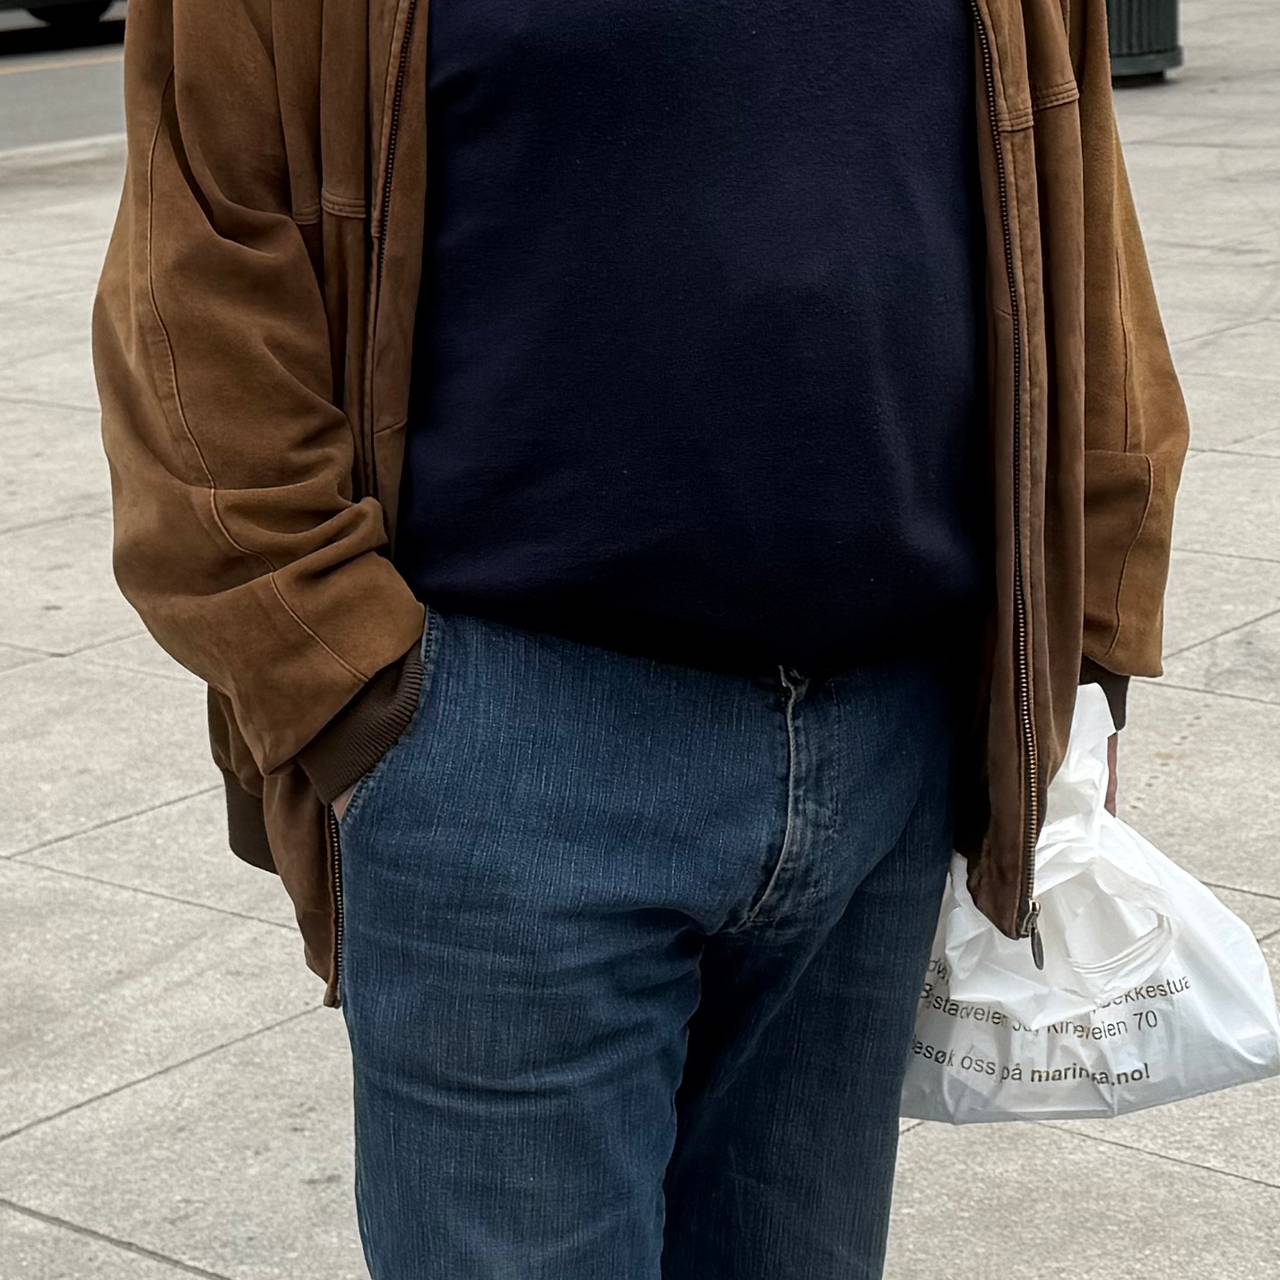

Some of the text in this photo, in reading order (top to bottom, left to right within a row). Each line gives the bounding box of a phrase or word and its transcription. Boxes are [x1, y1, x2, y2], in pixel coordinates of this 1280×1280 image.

[1133, 1009, 1158, 1031] 70
[912, 1035, 954, 1067] esøk
[960, 1055, 997, 1076] oss
[1001, 1063, 1022, 1083] på
